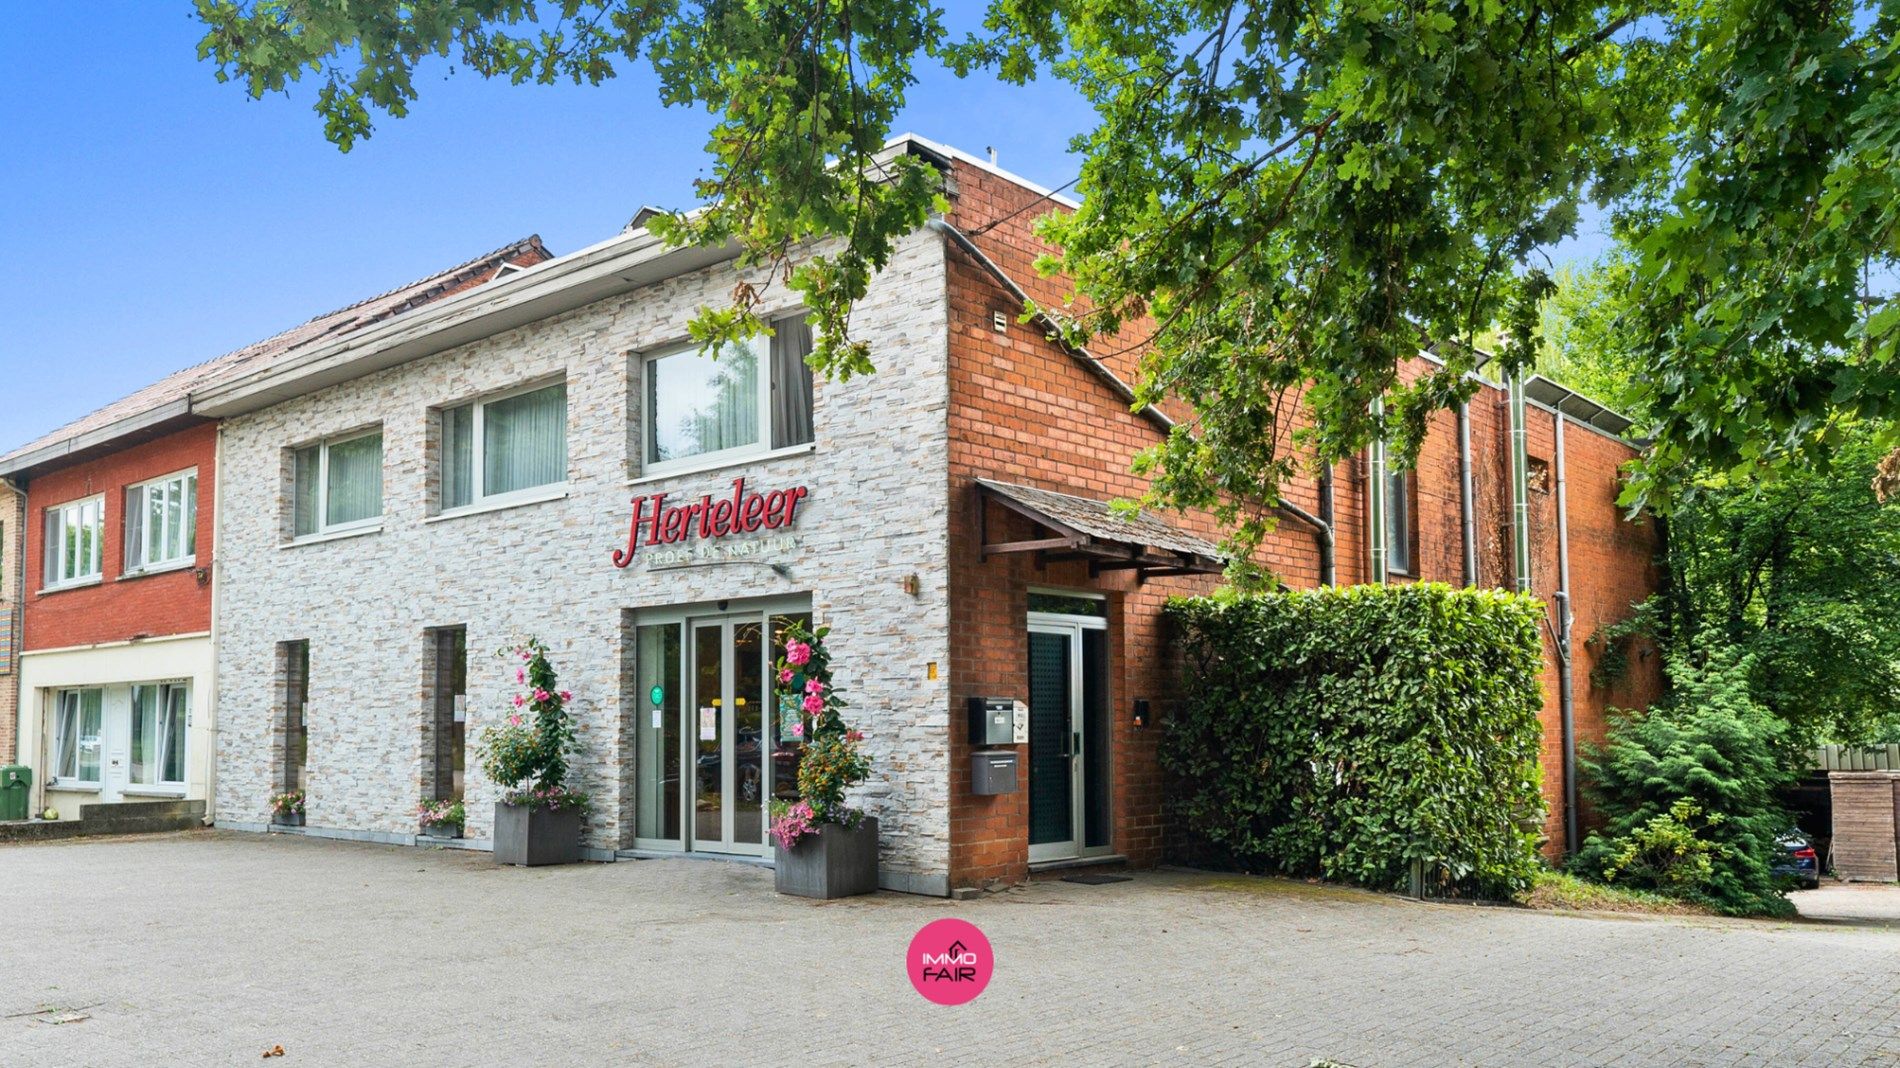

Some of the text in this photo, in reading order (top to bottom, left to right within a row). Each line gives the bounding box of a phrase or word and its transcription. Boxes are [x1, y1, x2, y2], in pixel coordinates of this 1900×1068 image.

[612, 477, 808, 568] Herteleer
[645, 535, 797, 565] PROEF DE NATUUR
